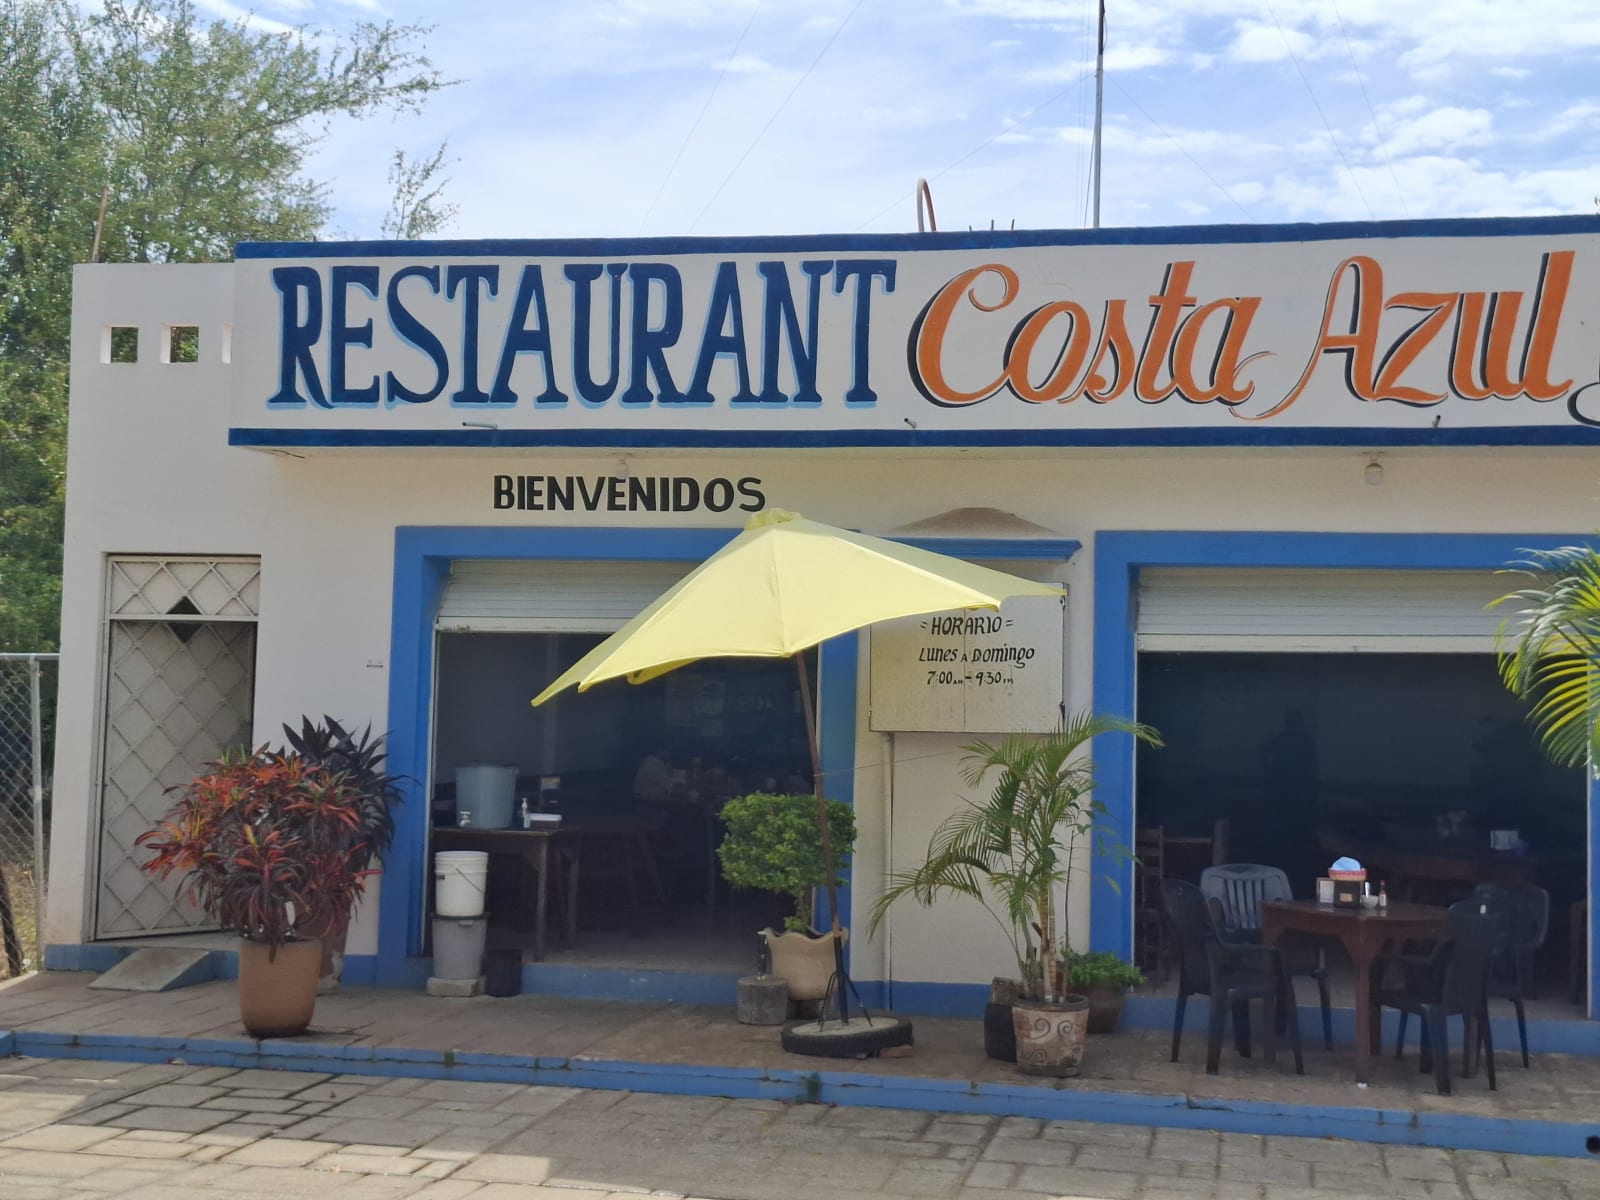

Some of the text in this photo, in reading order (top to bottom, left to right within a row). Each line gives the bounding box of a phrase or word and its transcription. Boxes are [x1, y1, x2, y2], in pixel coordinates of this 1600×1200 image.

[266, 250, 1576, 420] RESTAURANT Costa Azul
[493, 474, 766, 512] BIENVENIDOS
[931, 616, 1002, 635] HORARIO
[960, 653, 968, 663] A
[971, 643, 1035, 669] Domingo
